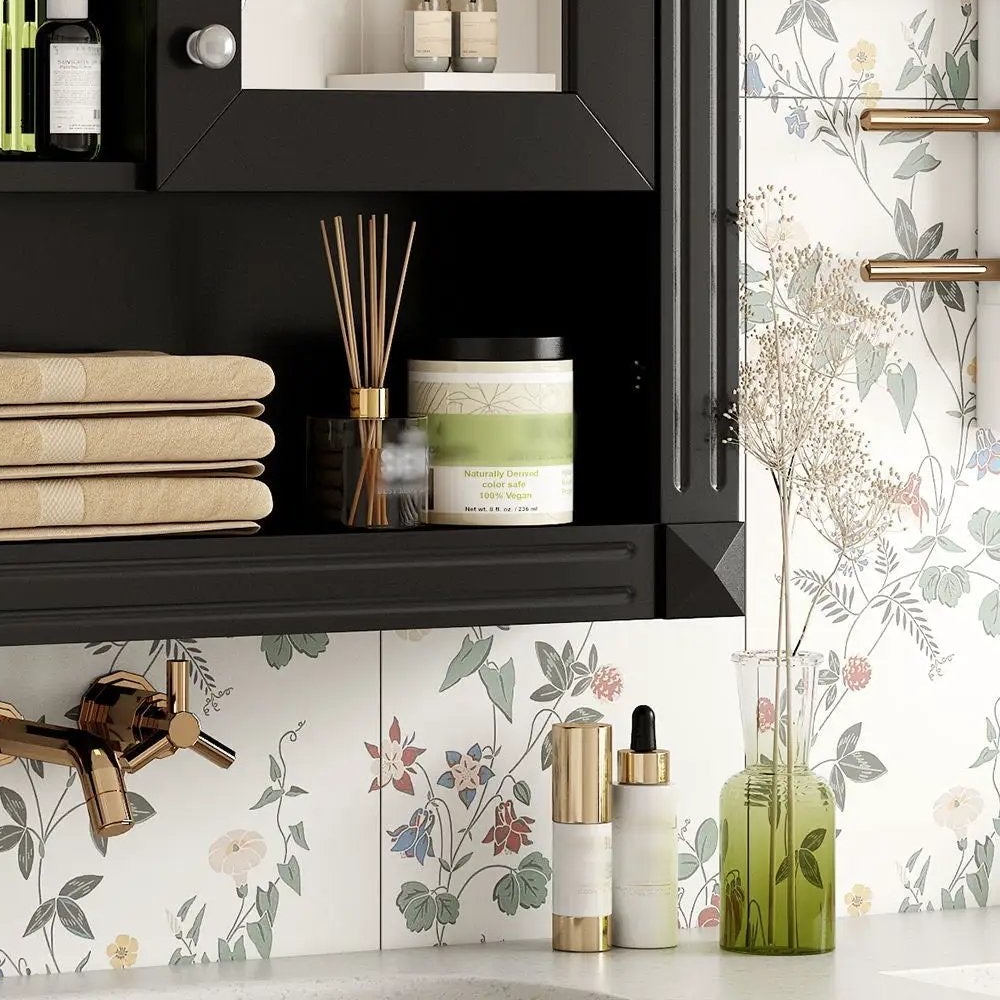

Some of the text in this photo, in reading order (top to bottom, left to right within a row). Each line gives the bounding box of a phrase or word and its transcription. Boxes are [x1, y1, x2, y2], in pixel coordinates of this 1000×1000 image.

[464, 470, 504, 478] Naturally
[507, 480, 526, 488] safe
[506, 492, 532, 500] Vegan
